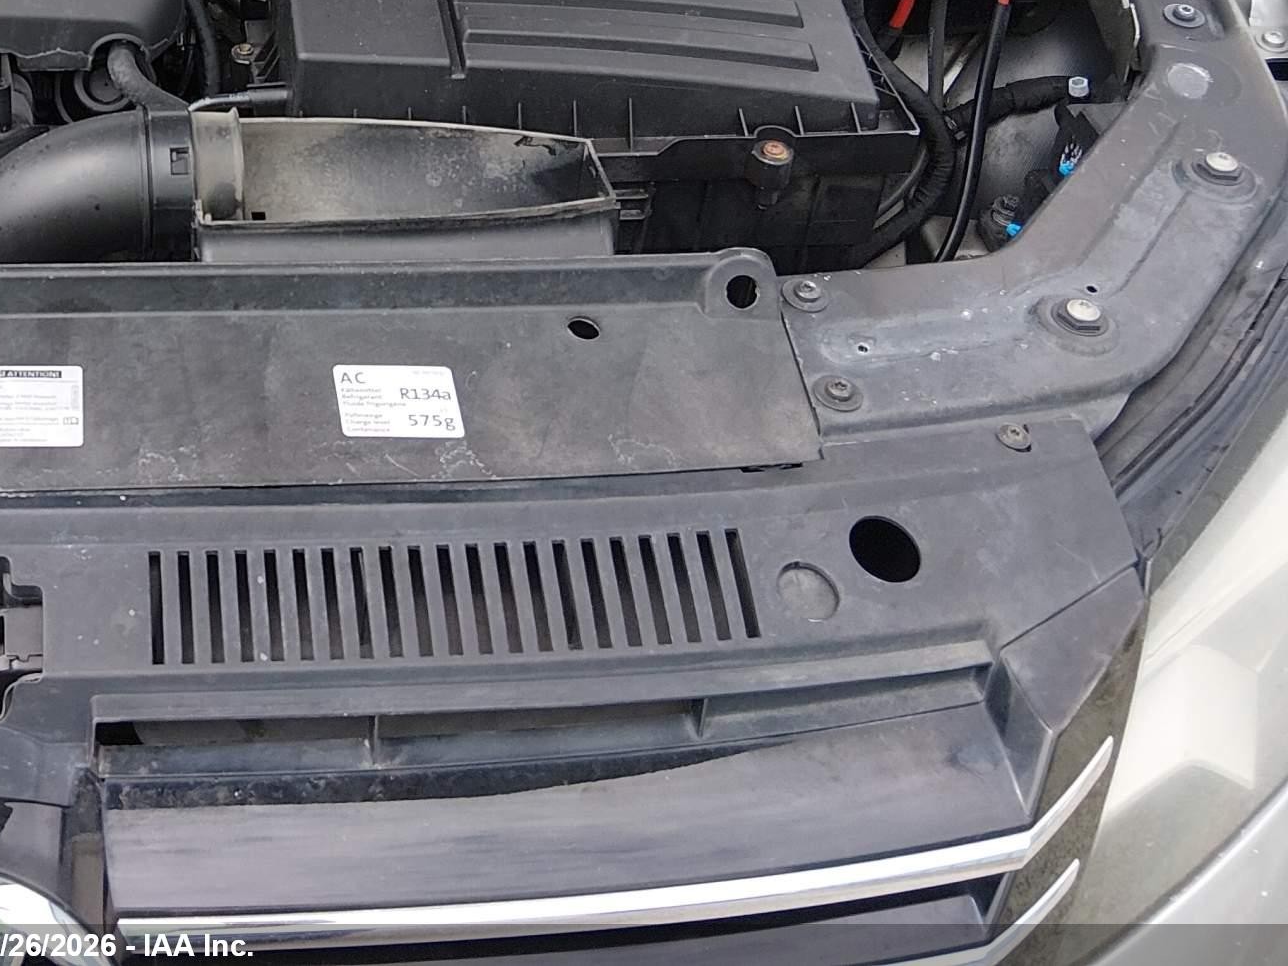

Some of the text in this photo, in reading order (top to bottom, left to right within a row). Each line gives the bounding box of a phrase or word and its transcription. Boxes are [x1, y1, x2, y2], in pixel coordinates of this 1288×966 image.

[341, 372, 366, 384] AC
[399, 387, 452, 401] R134a
[408, 414, 456, 431] 575g
